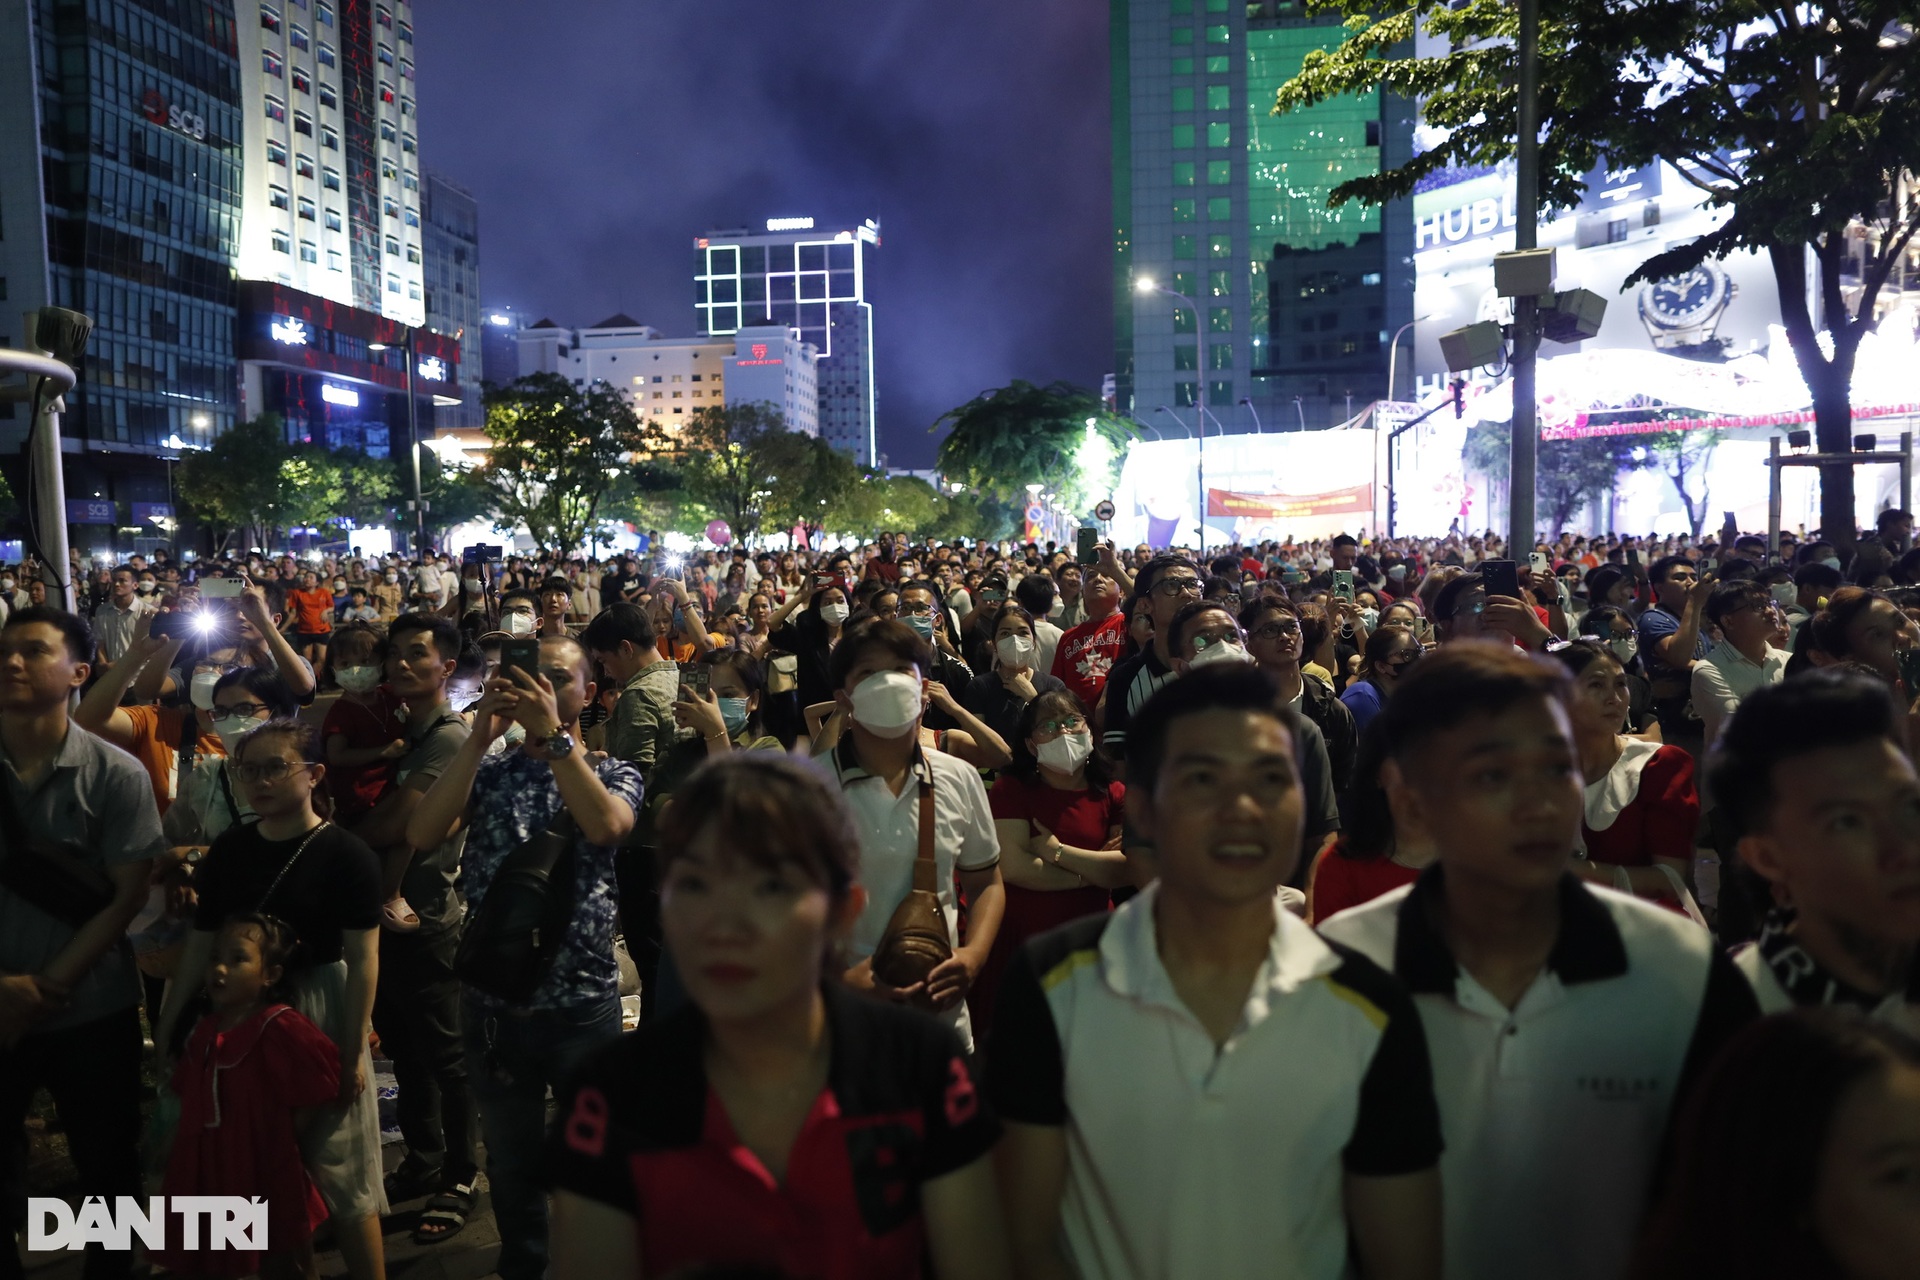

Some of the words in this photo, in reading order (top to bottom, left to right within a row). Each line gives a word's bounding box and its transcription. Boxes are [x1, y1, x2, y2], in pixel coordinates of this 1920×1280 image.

[169, 104, 205, 141] SCB
[88, 503, 109, 516] SCB
[1064, 629, 1126, 659] CANADA
